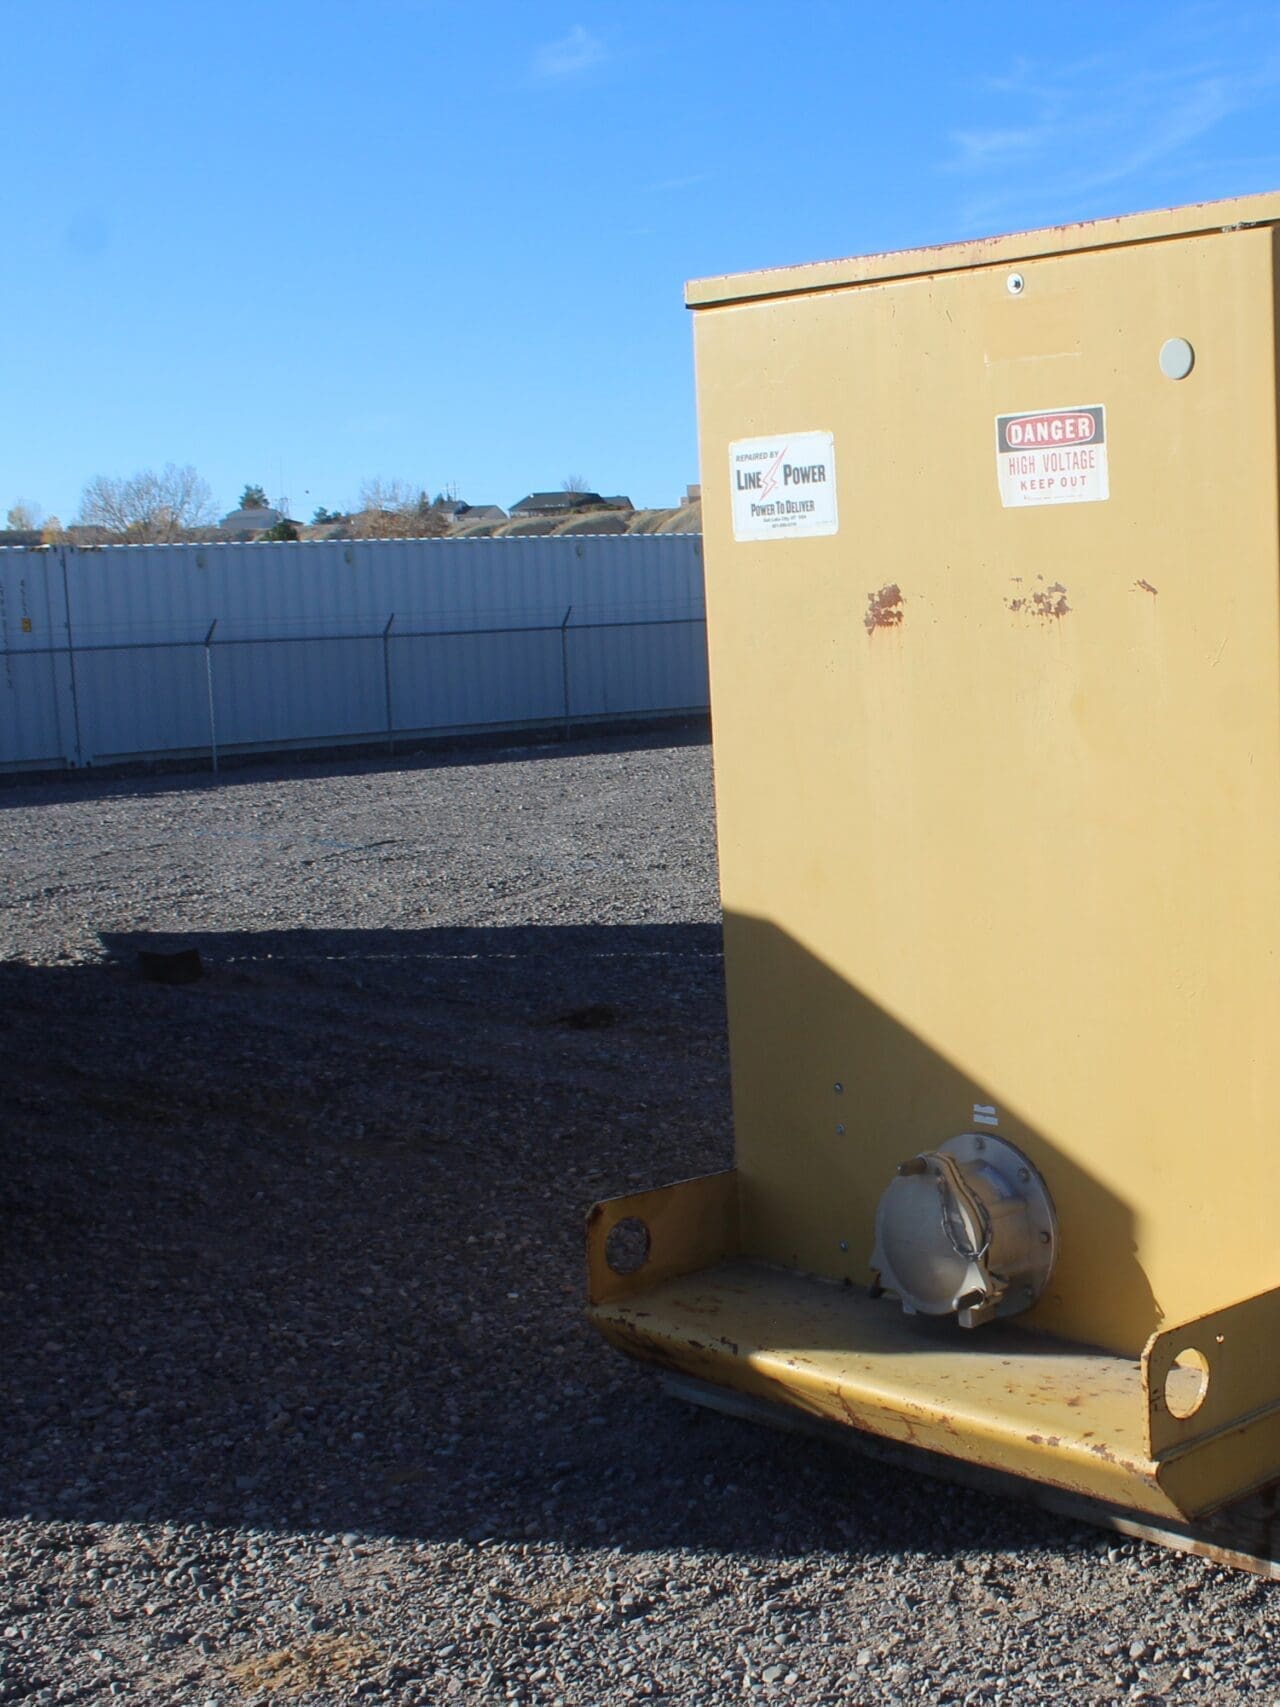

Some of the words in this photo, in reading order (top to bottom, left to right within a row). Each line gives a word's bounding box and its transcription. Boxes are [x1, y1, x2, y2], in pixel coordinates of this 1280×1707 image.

[1010, 417, 1091, 445] DANGER
[736, 451, 768, 462] REPAIRED
[769, 450, 779, 459] BY
[1008, 455, 1036, 476] HIGH
[1043, 449, 1096, 473] VOLTAGE
[736, 469, 763, 491] LINE
[783, 463, 826, 486] POWER
[1020, 478, 1055, 491] KEEP
[1060, 475, 1087, 488] OUT
[751, 503, 775, 517] POWER
